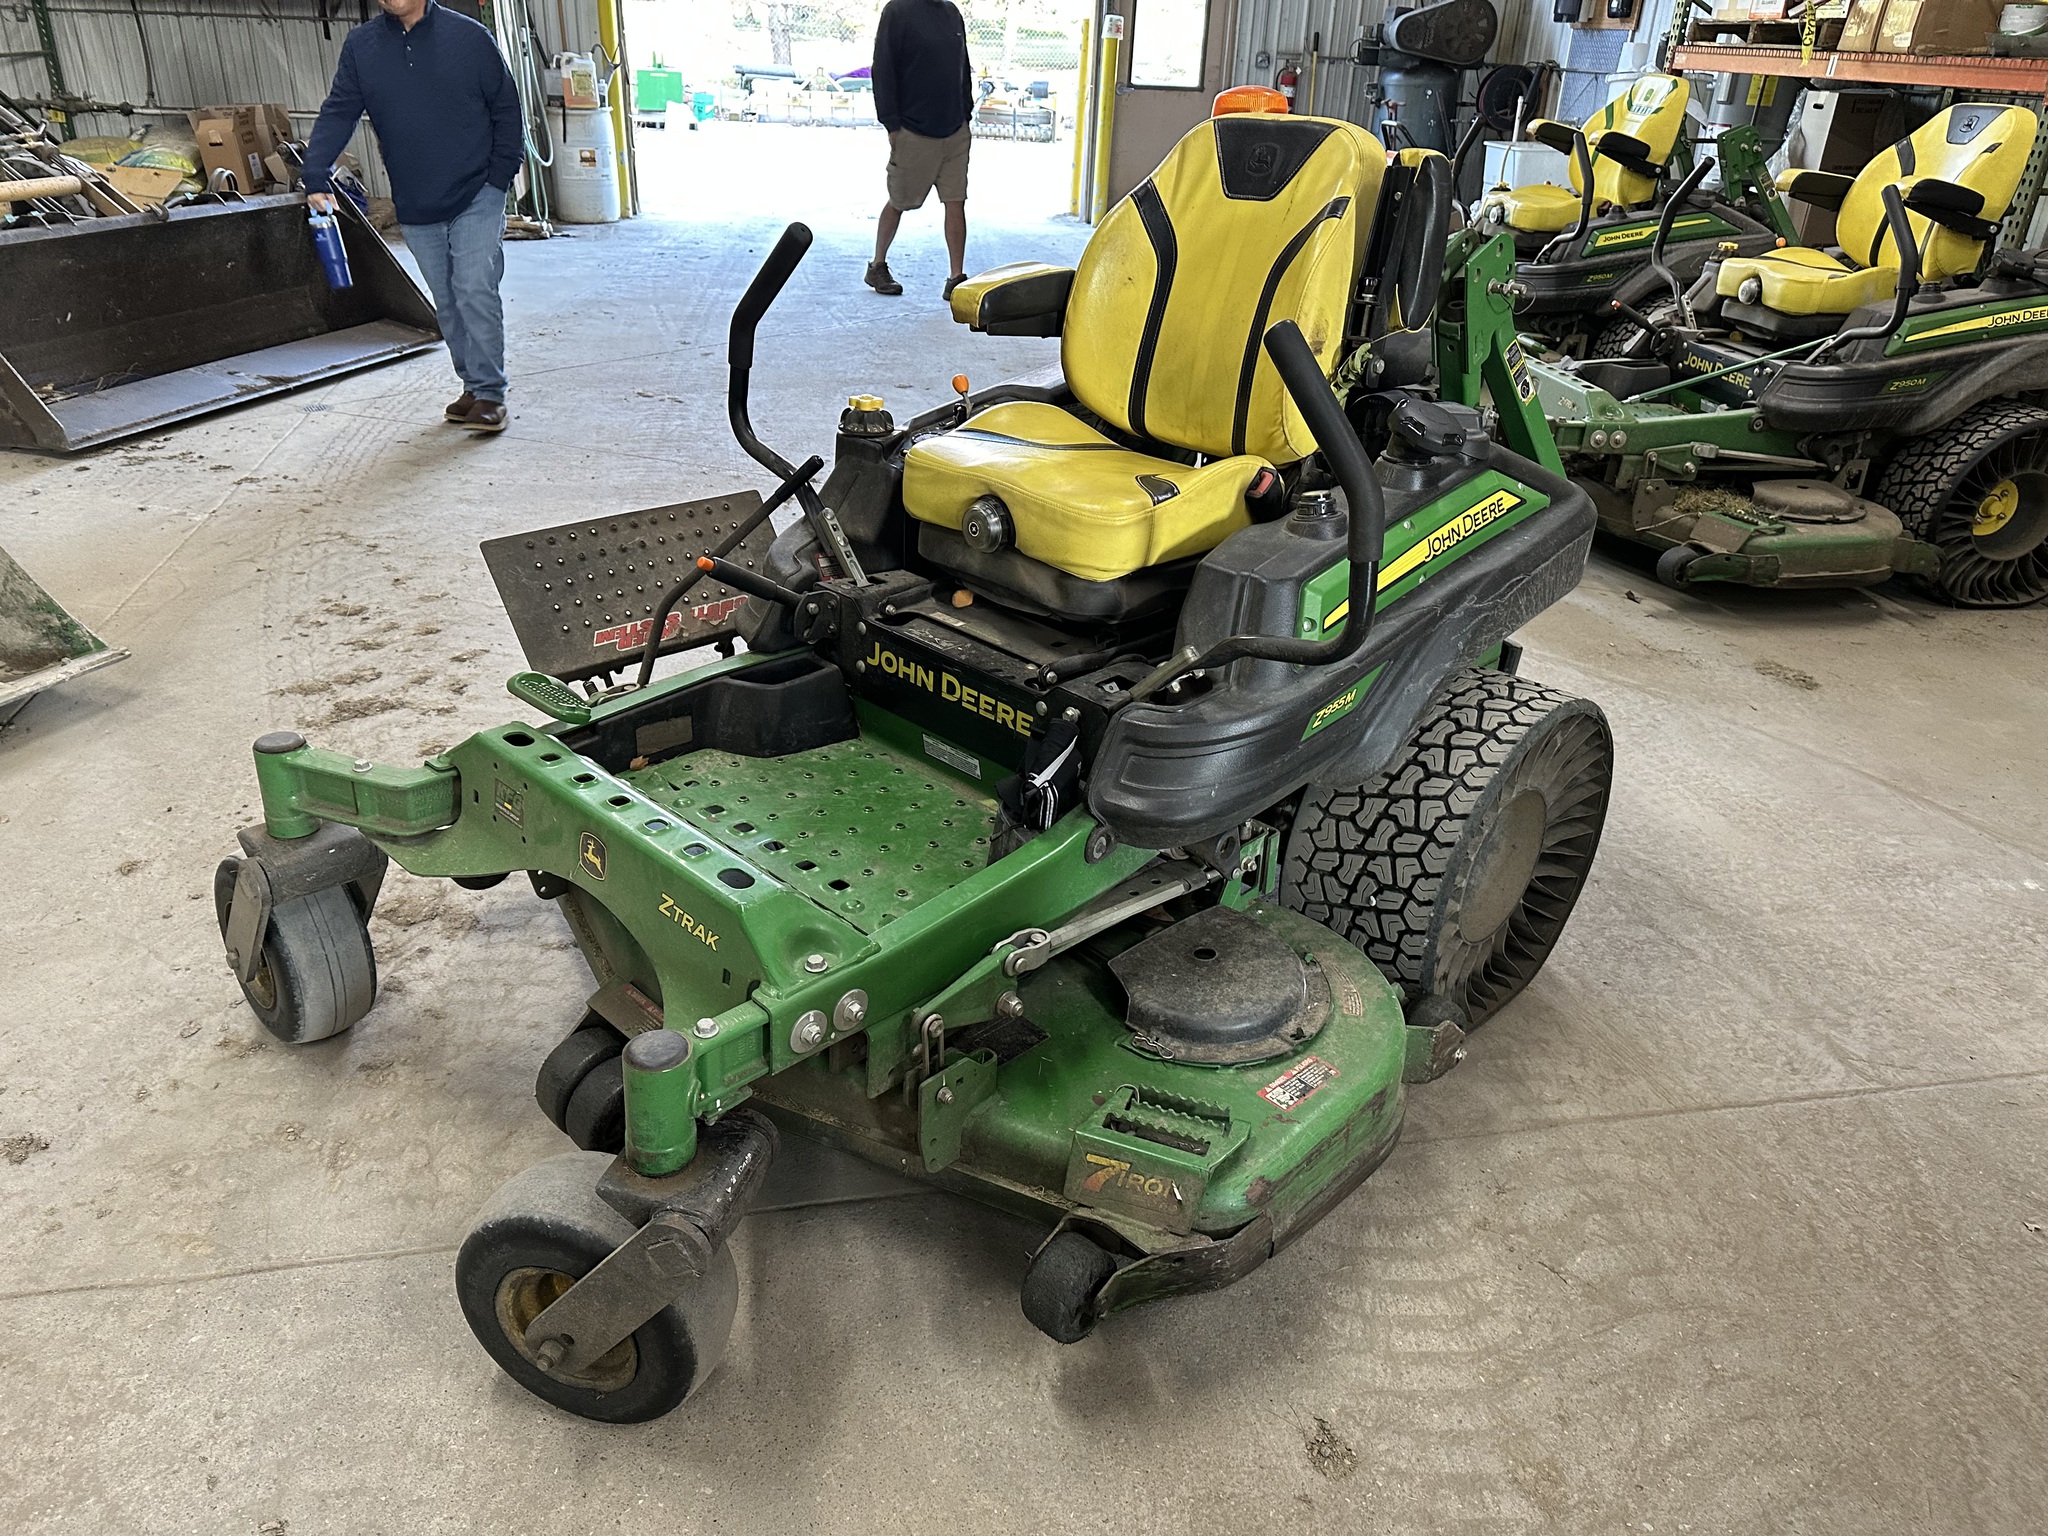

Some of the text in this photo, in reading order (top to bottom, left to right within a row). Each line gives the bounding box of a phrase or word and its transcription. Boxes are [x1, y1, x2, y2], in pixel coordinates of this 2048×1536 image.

[1603, 230, 1644, 243] JOHN DEERE
[1987, 309, 2048, 328] JOHN DEE
[1683, 351, 1752, 390] JOHN DERE
[1889, 378, 1926, 391] Z950M
[1424, 496, 1506, 560] JOHN DEERE
[594, 612, 682, 646] SSTEM
[866, 641, 1034, 738] JOHN DEERE
[1311, 688, 1357, 729] Z955M
[658, 891, 721, 953] ZTRAK
